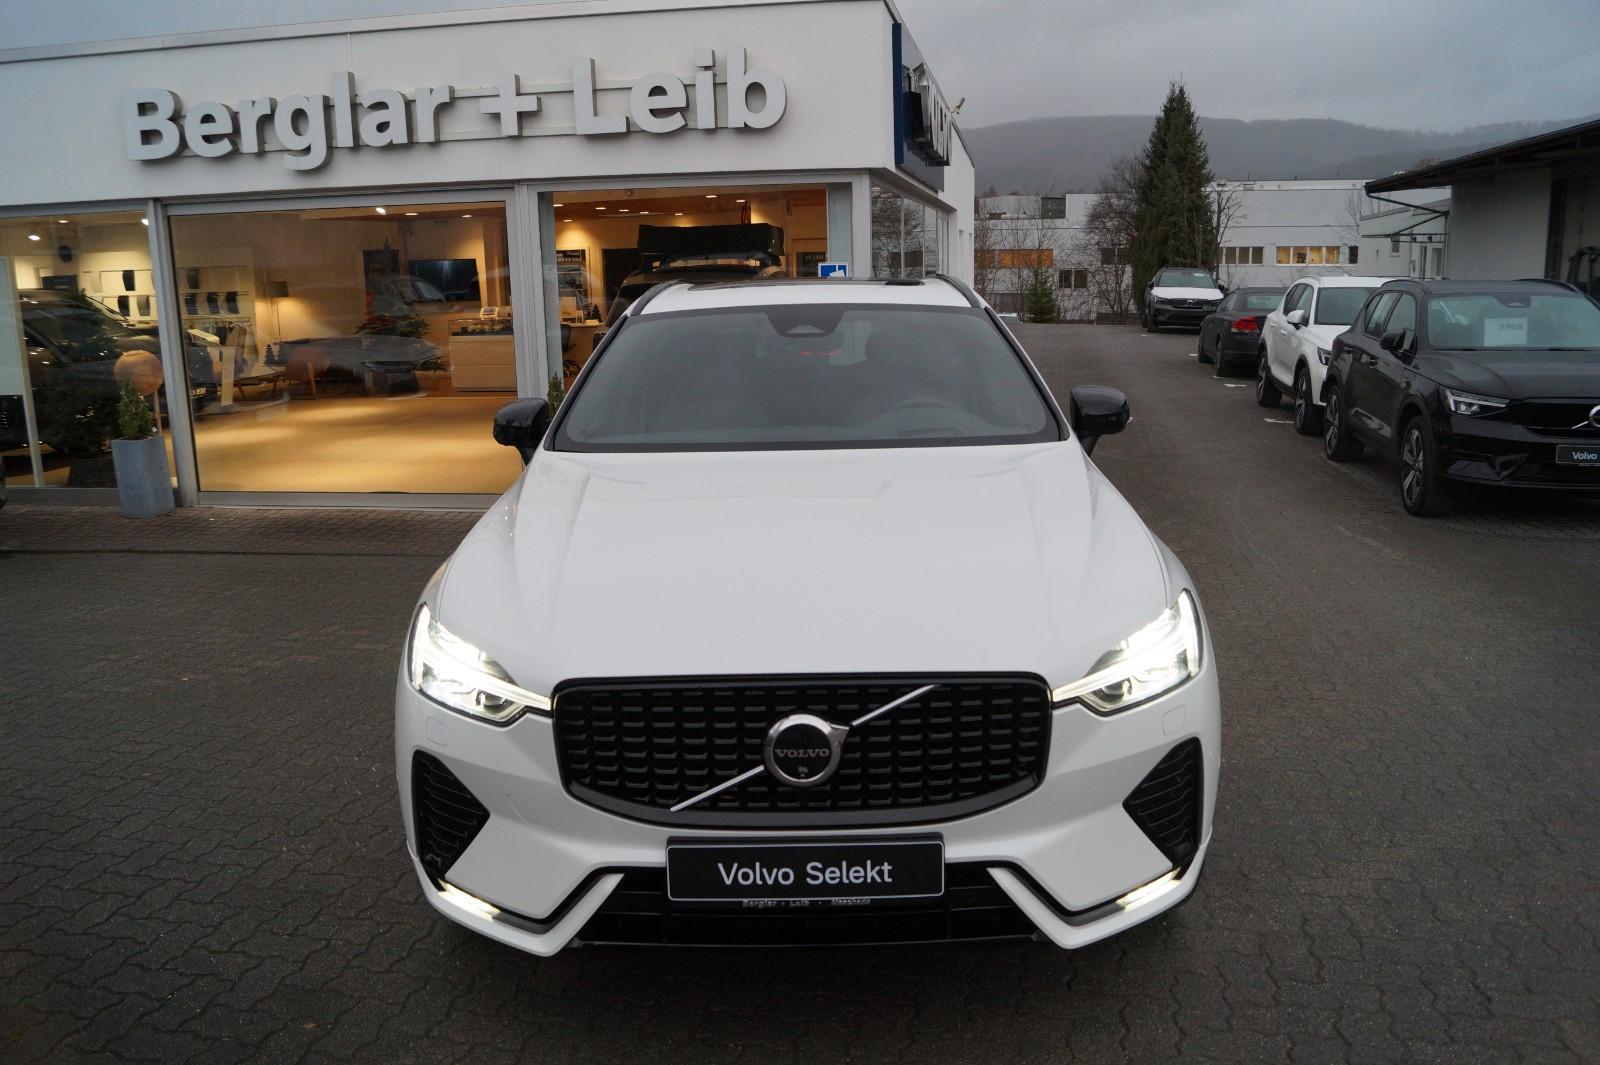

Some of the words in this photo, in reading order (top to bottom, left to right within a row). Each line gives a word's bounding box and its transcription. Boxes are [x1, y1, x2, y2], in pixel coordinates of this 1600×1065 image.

[121, 70, 454, 171] Berglar
[480, 73, 542, 136] +
[573, 47, 787, 134] Leib
[1572, 451, 1598, 460] Volvo
[774, 748, 830, 758] VOLVO
[717, 861, 795, 886] Volvo
[805, 859, 893, 884] Selekt
